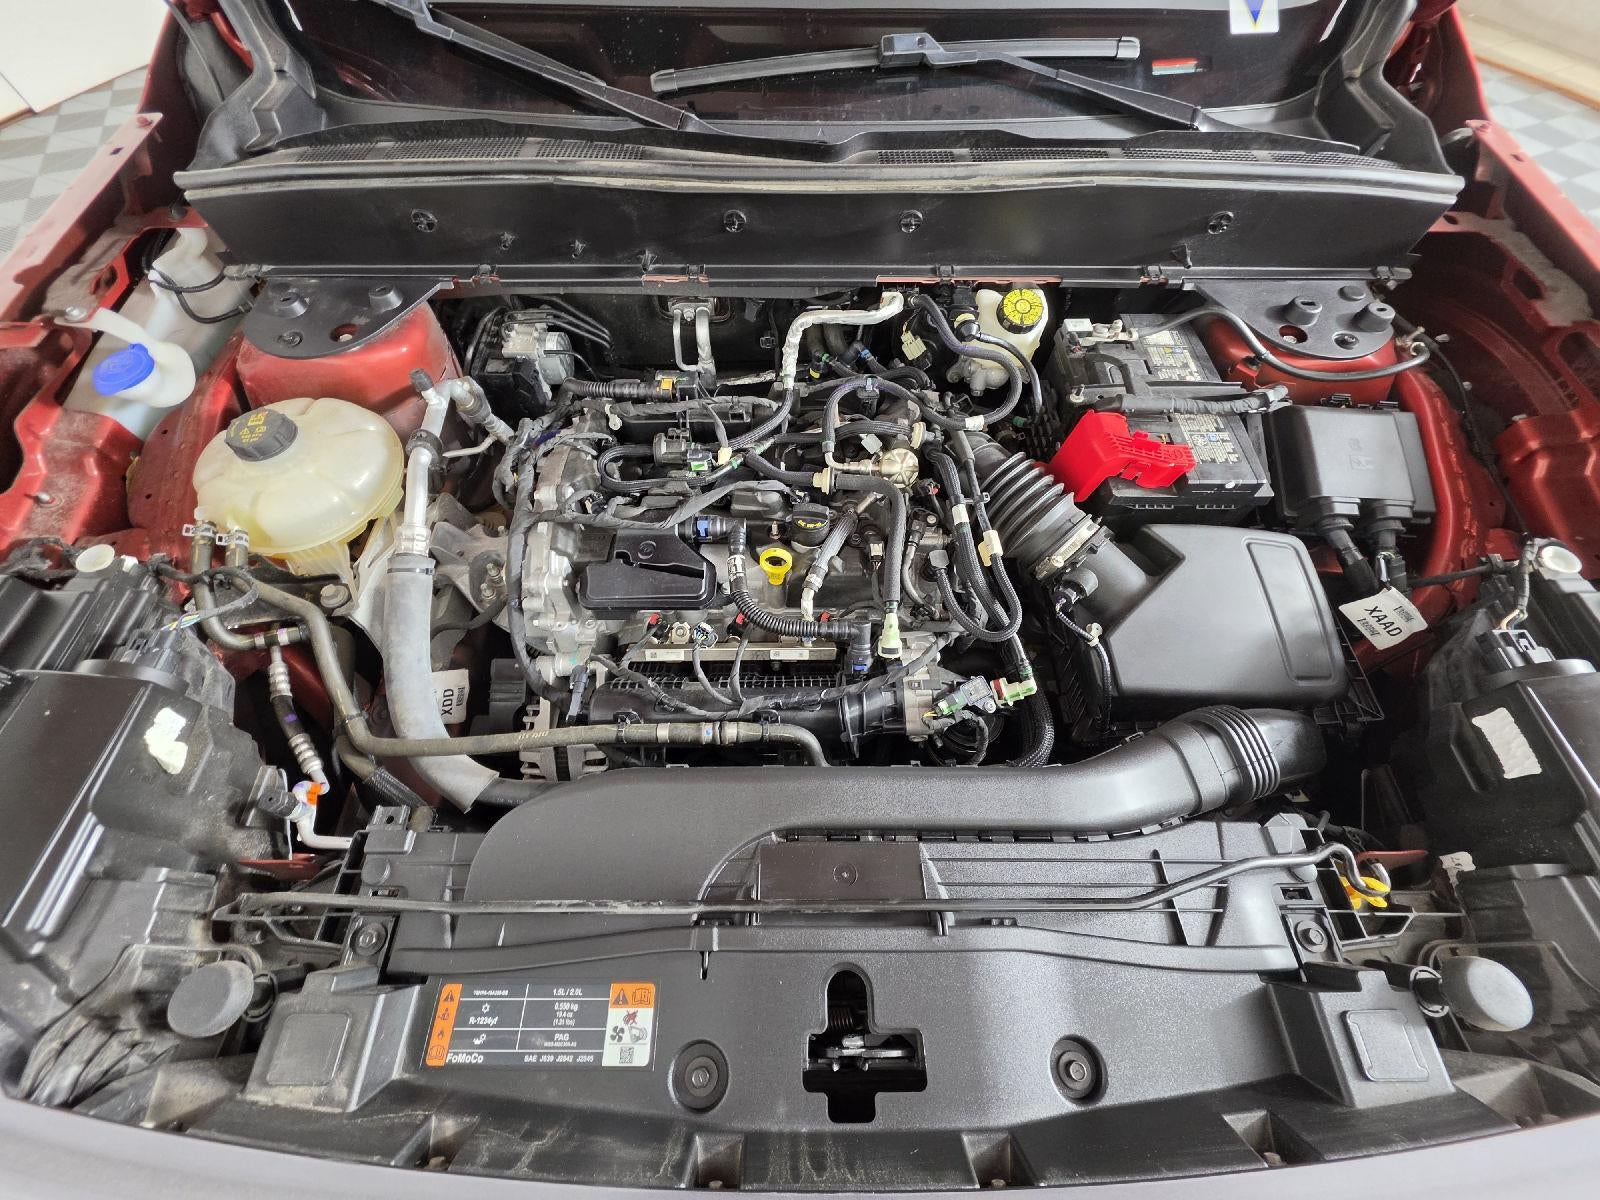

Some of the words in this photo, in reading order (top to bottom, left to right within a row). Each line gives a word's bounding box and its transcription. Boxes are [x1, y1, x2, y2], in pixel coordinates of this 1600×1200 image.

[1364, 605, 1403, 637] XAAD
[440, 688, 454, 716] XDD
[570, 1002, 579, 1012] kg
[469, 1016, 499, 1027] R-1234yf
[554, 1033, 570, 1041] PAG
[446, 1053, 484, 1064] FoMoCo
[524, 1055, 538, 1063] SAE
